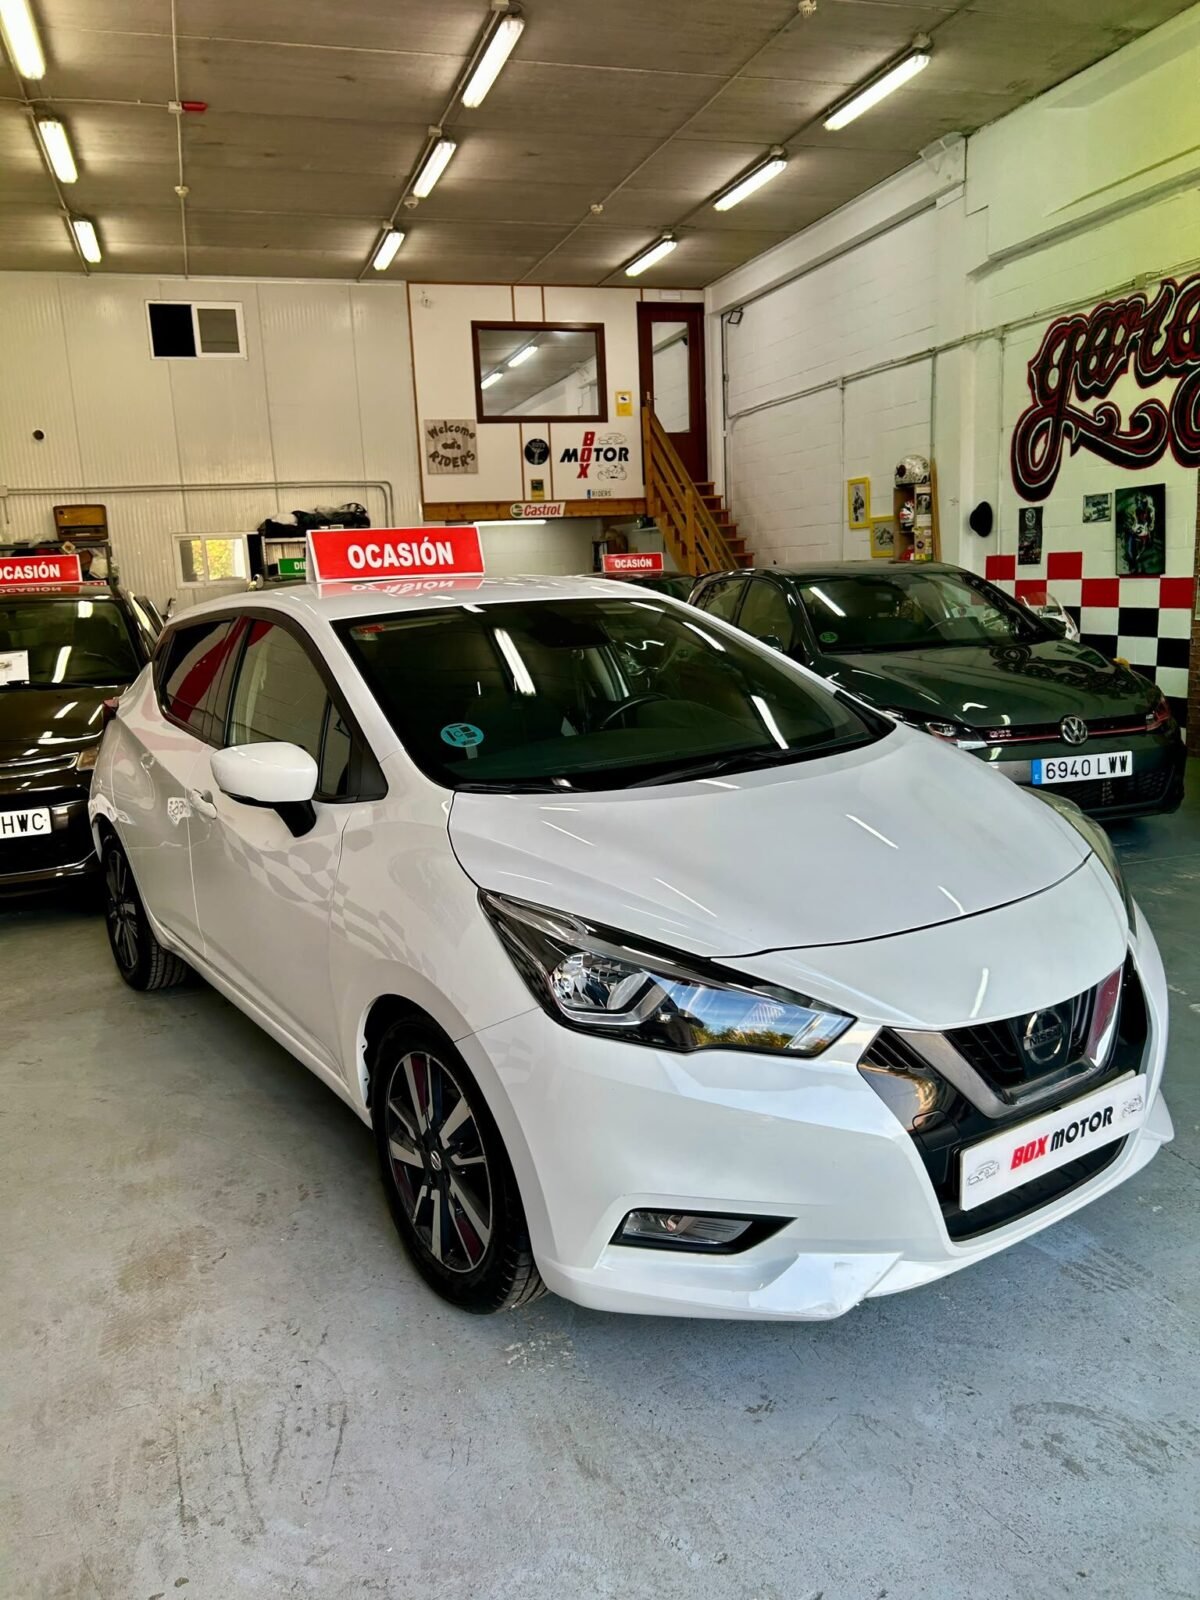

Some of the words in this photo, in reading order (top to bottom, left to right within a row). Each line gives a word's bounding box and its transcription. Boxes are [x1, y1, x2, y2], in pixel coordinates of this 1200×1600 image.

[427, 420, 476, 440] Welcome
[429, 450, 475, 468] RIDERS
[577, 431, 595, 479] BOX
[524, 504, 561, 516] Castrol
[347, 536, 454, 570] OCASIÓN
[614, 556, 653, 568] OCASIÓN
[0, 561, 61, 580] CASIÓN
[1045, 759, 1091, 780] 6940
[1097, 755, 1128, 774] LWW
[1, 813, 44, 834] HWC
[1029, 1024, 1063, 1047] NISS
[1010, 1134, 1050, 1170] BOX
[1050, 1105, 1114, 1152] MOTOR
